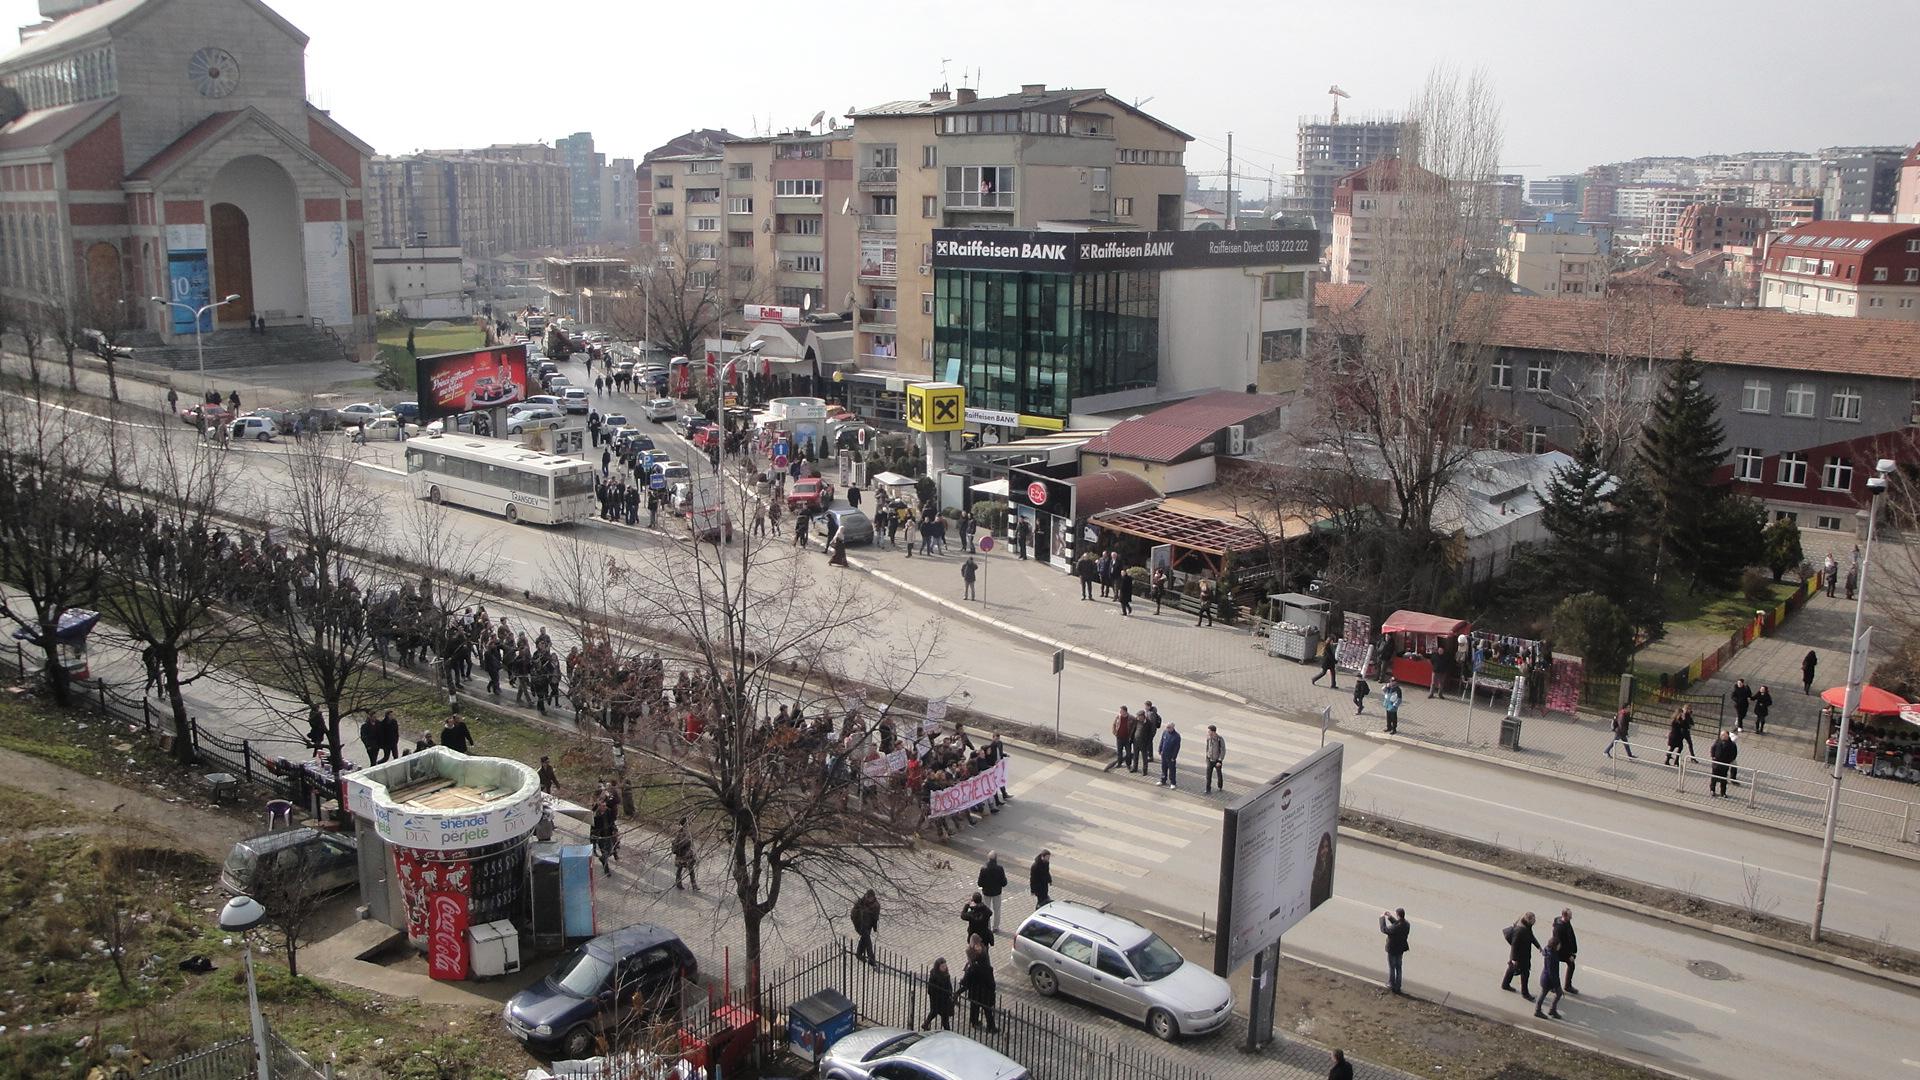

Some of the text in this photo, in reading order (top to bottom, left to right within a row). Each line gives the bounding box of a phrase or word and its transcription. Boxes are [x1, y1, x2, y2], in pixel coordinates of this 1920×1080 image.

[949, 240, 1067, 260] Raiffeisen BANK
[1090, 242, 1175, 258] Raiffeisen BANK
[1209, 240, 1242, 253] Raiffeisen
[1265, 240, 1279, 252] 038
[1281, 240, 1294, 252] 222
[1295, 239, 1309, 252] 222
[760, 307, 783, 319] Fellini
[996, 414, 1015, 424] BANK
